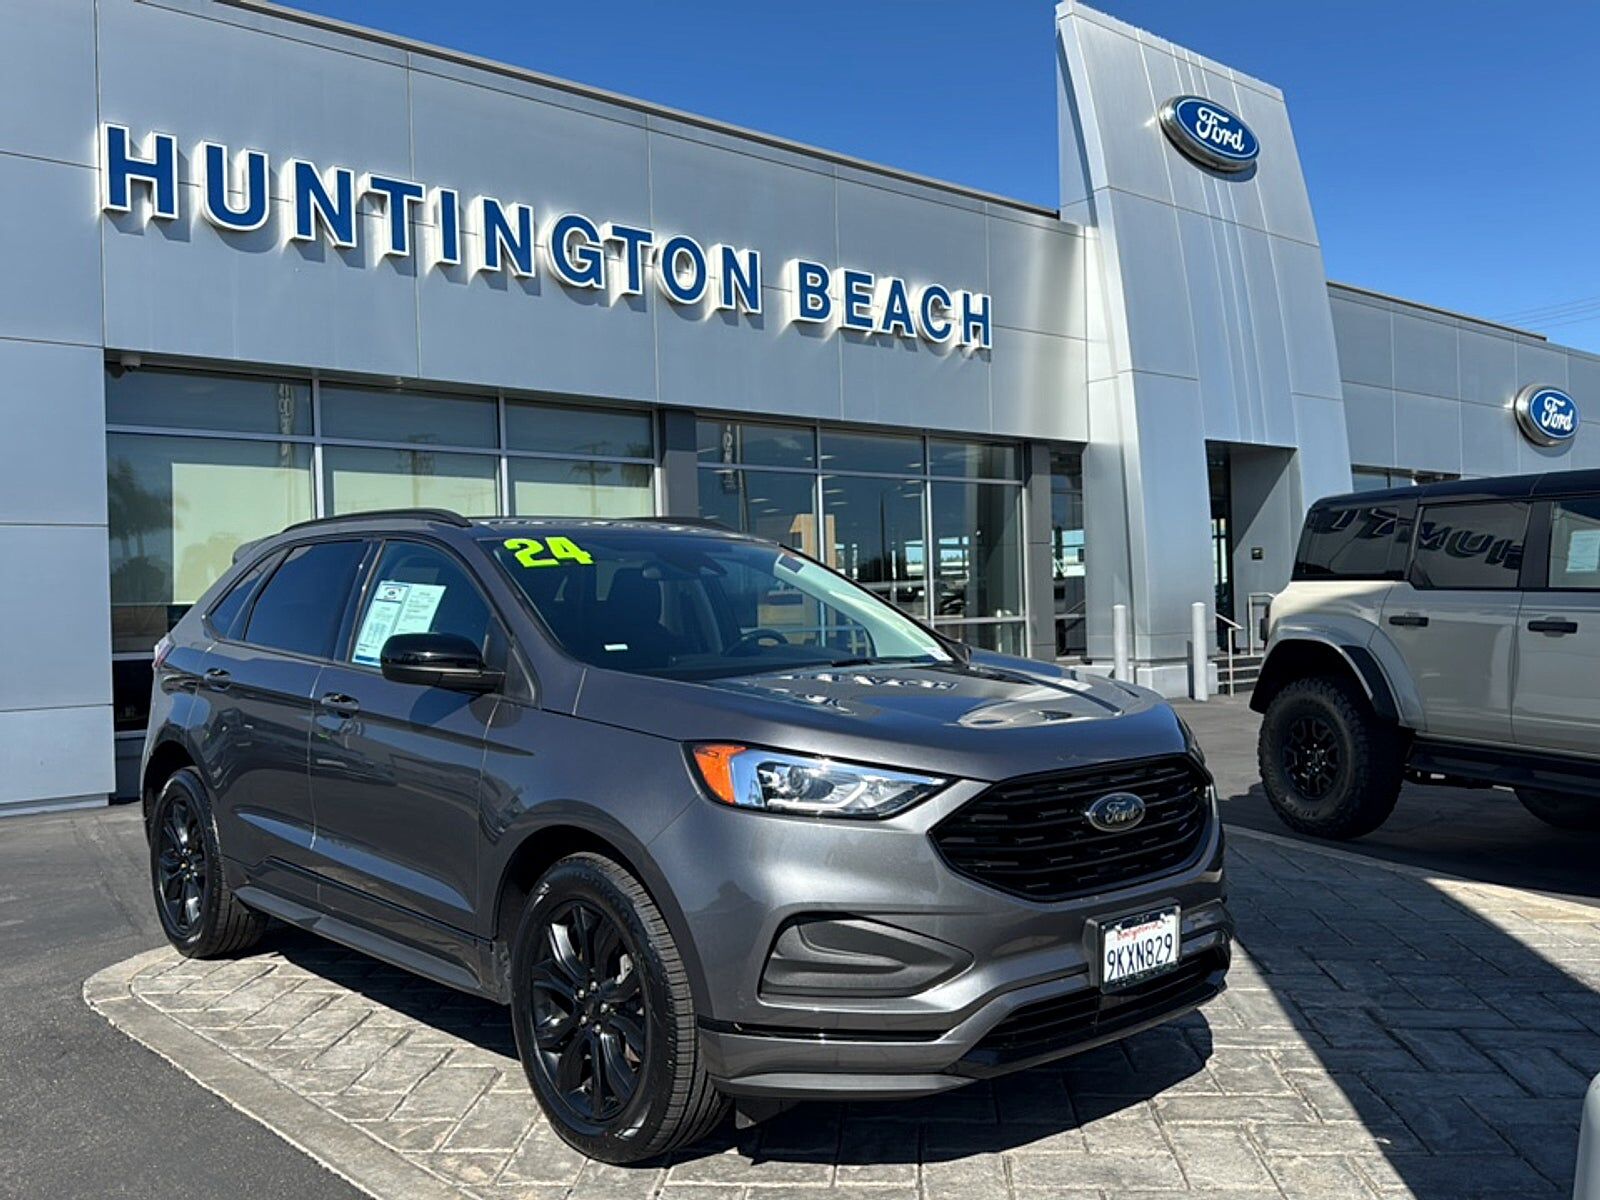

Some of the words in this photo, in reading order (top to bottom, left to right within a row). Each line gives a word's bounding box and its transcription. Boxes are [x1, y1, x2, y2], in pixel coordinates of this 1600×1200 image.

[1196, 106, 1244, 152] Ford
[103, 122, 762, 314] HUNTINGTON
[789, 257, 992, 350] BEACH
[1541, 396, 1574, 431] Ford
[503, 536, 594, 568] 24
[1105, 801, 1139, 824] Ford
[1106, 933, 1173, 981] 9KXN829
